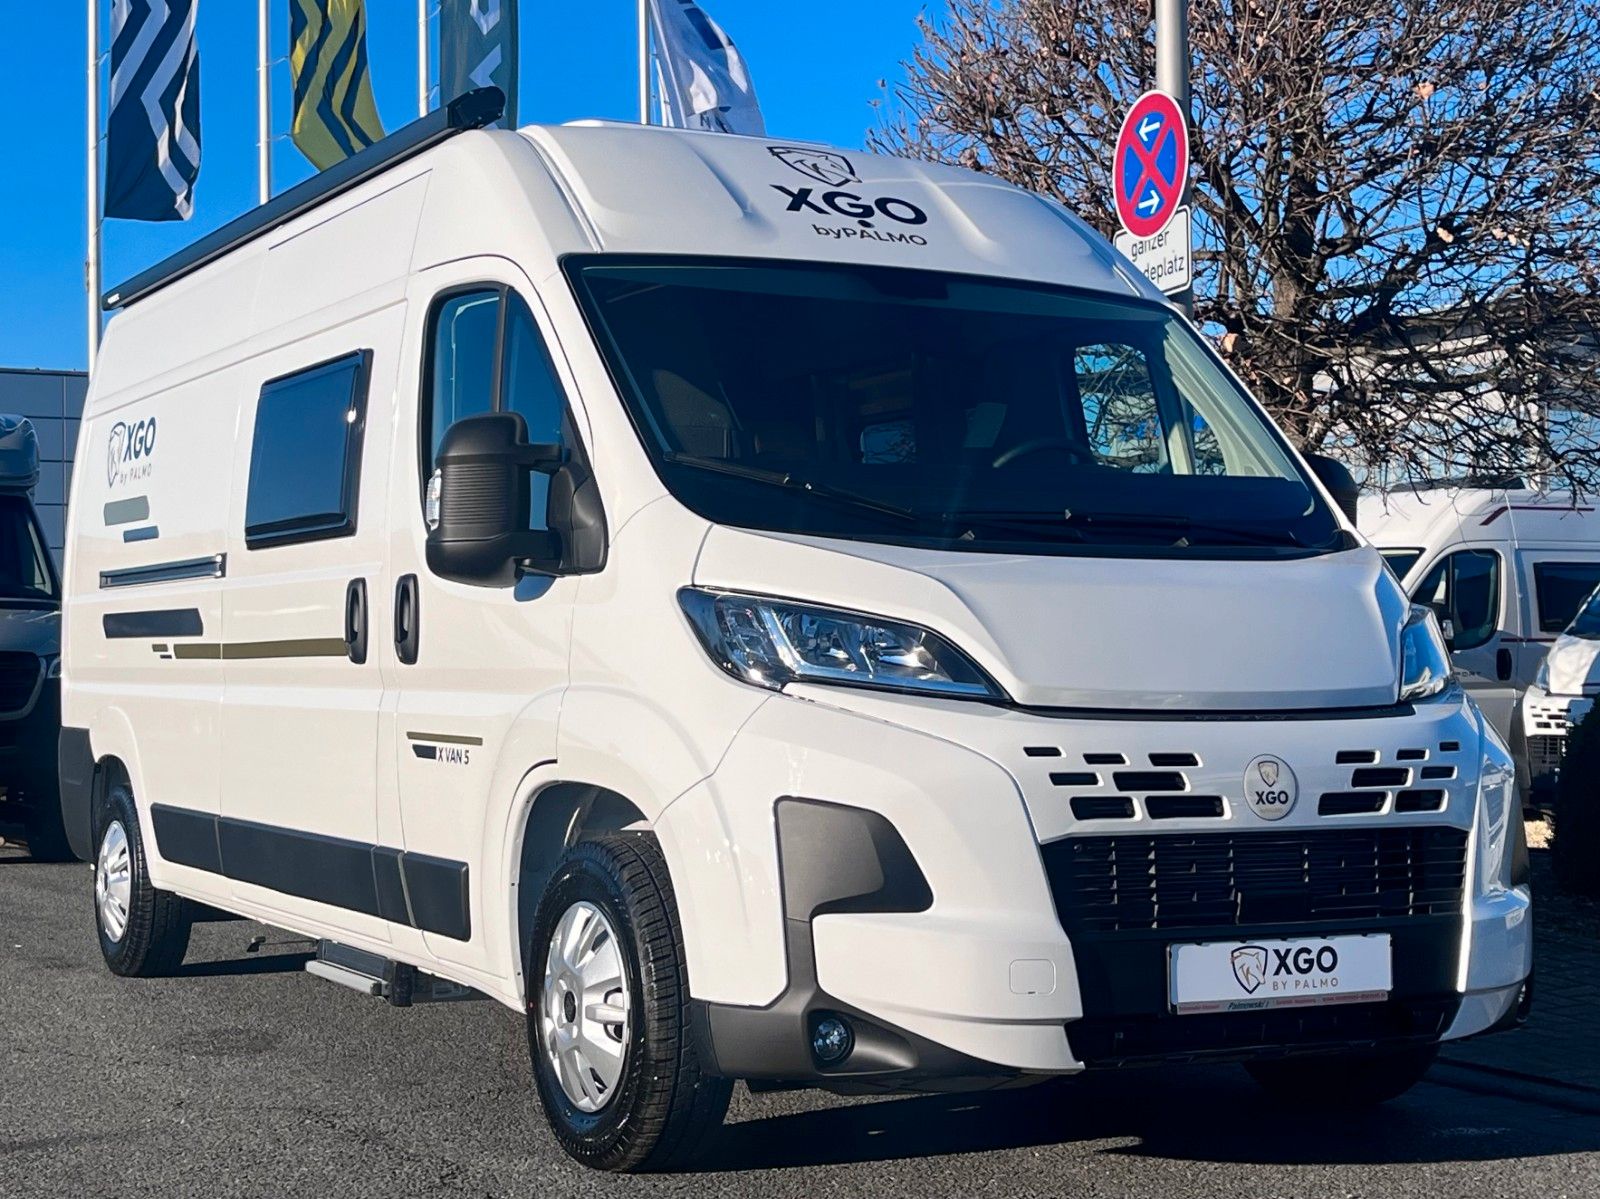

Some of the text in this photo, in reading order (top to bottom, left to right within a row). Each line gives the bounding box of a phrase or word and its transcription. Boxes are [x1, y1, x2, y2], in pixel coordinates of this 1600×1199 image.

[769, 184, 928, 225] XGO
[1131, 231, 1169, 262] ganzer
[1144, 255, 1185, 284] deplatz
[123, 417, 156, 463] XGO
[445, 747, 462, 764] VAN
[464, 750, 470, 765] 5
[1255, 790, 1289, 805] XGO
[1272, 945, 1339, 976] XGO
[1272, 977, 1339, 991] BY PALMO
